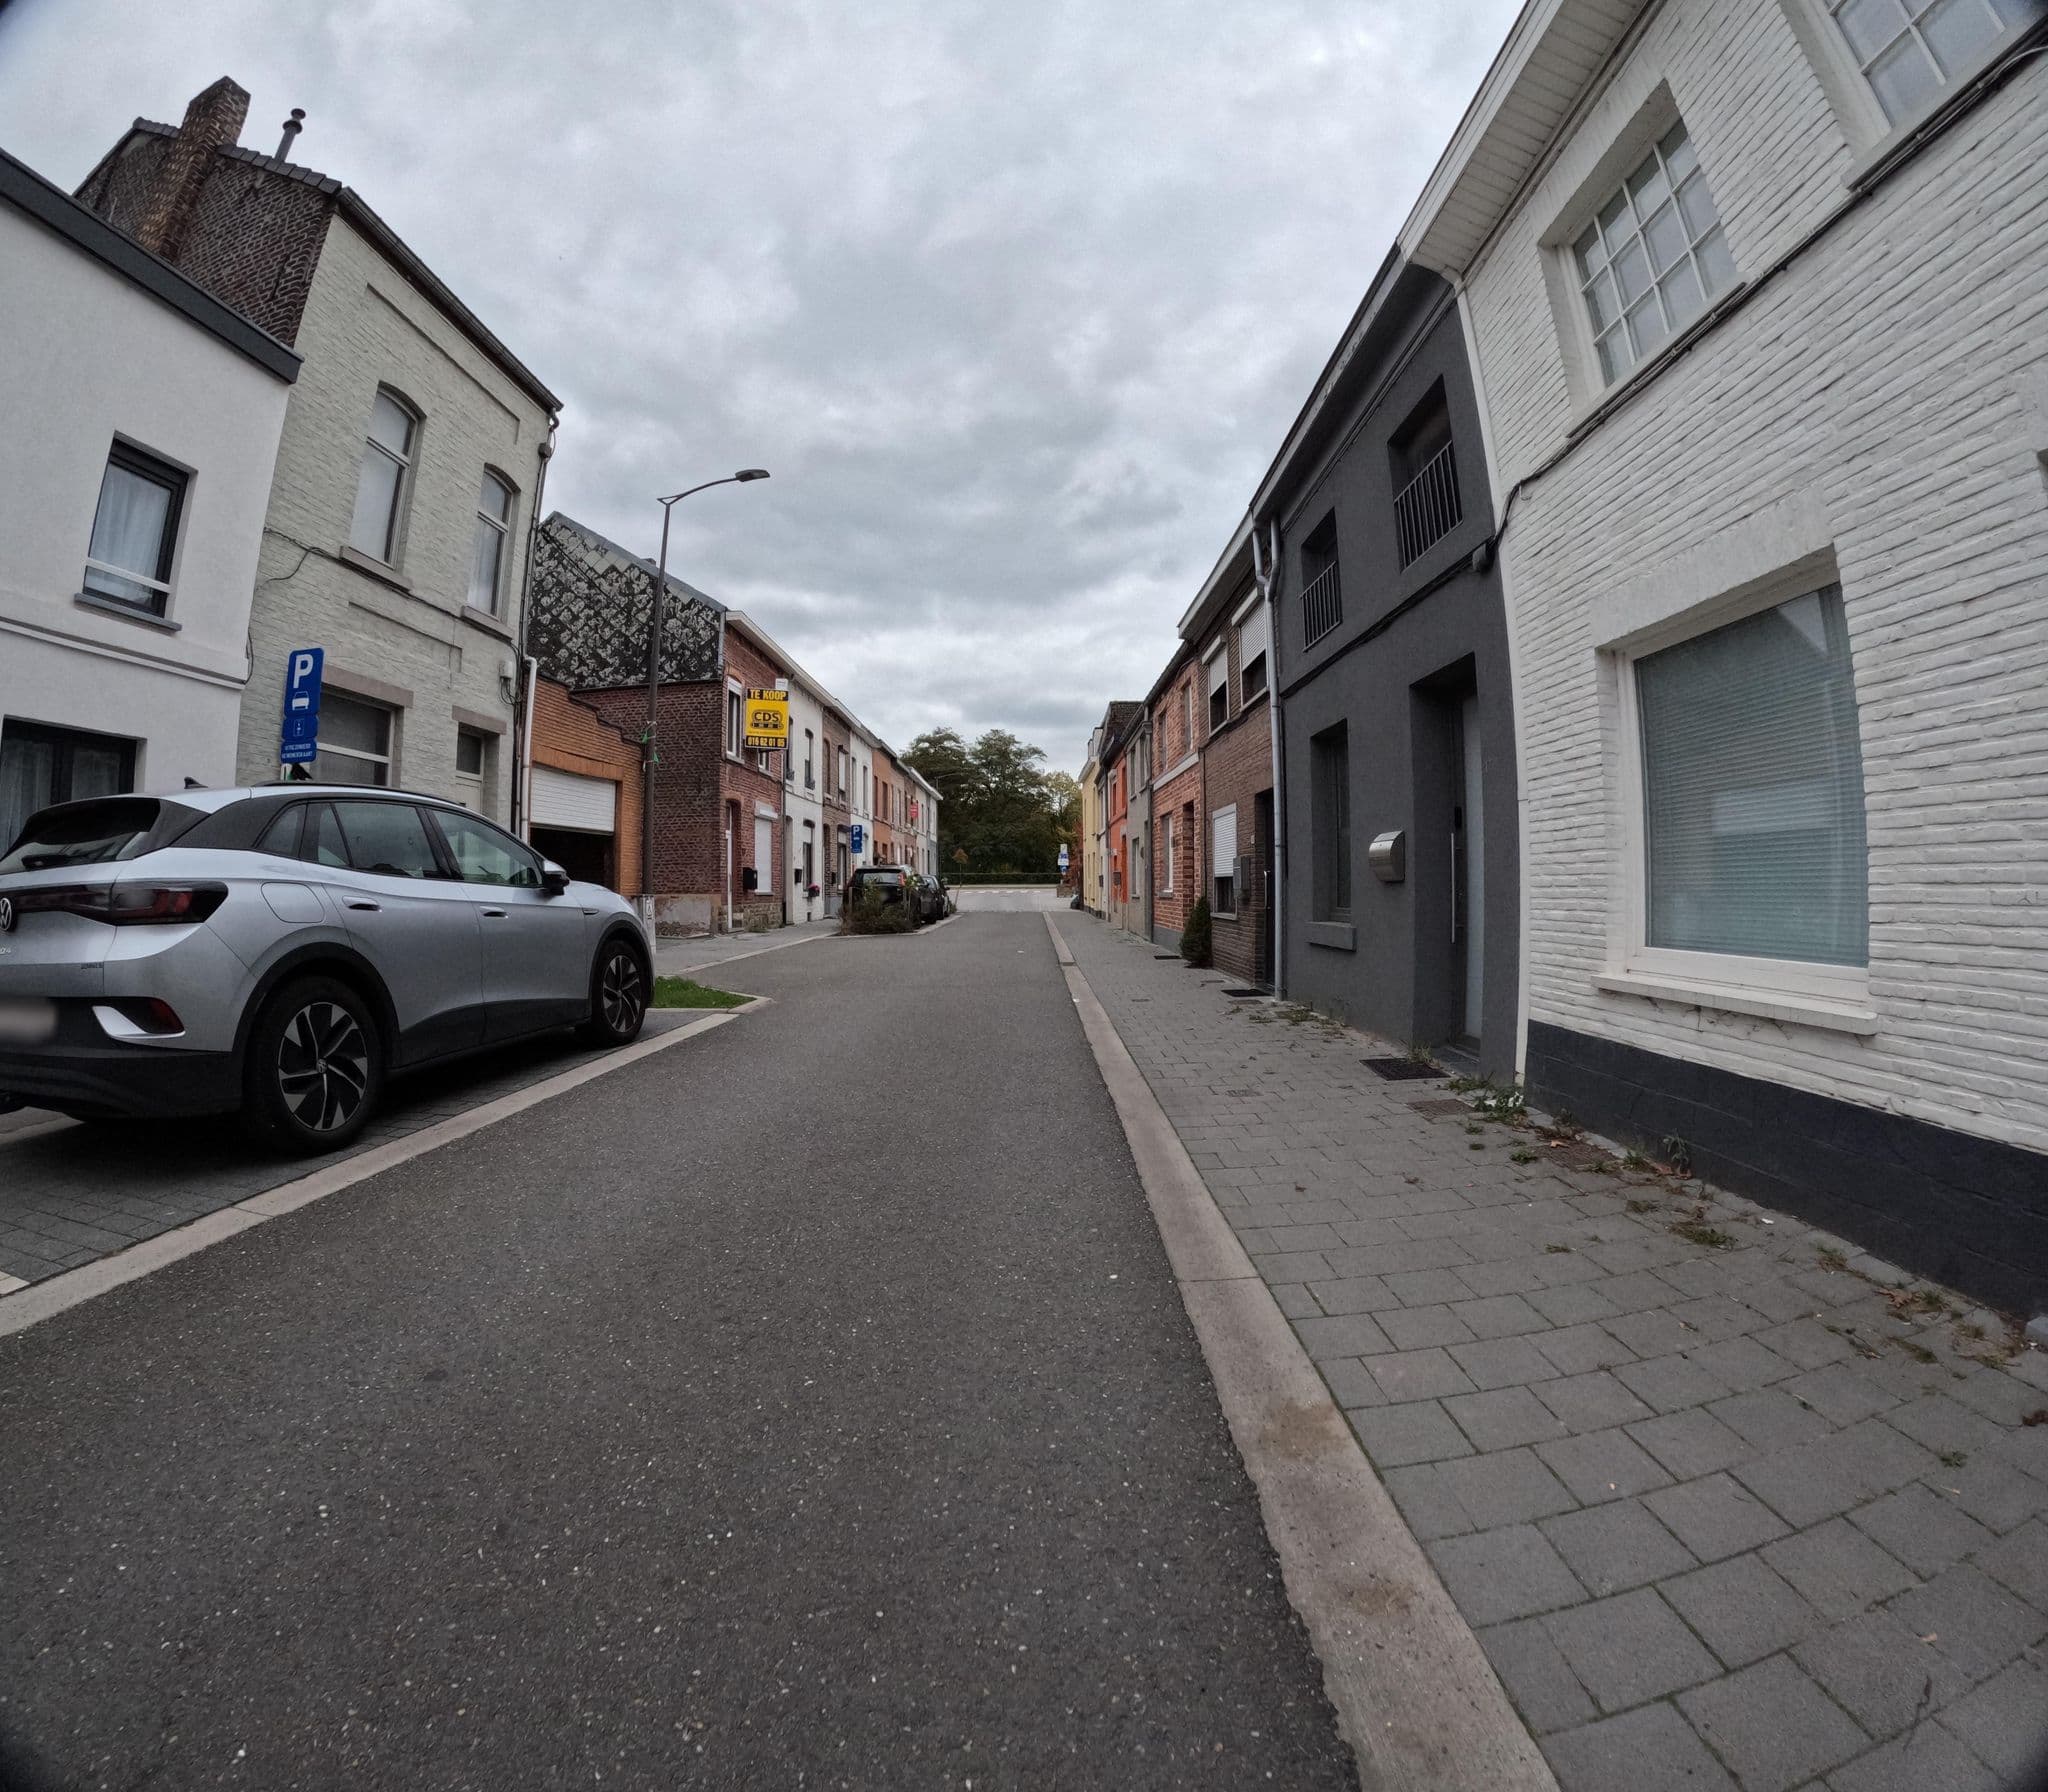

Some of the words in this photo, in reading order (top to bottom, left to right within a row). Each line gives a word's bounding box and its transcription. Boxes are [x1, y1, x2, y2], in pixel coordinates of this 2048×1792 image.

[293, 654, 314, 689] P
[750, 689, 761, 699] TE
[763, 690, 786, 700] KOOP
[754, 712, 779, 722] CDS
[853, 826, 860, 835] P
